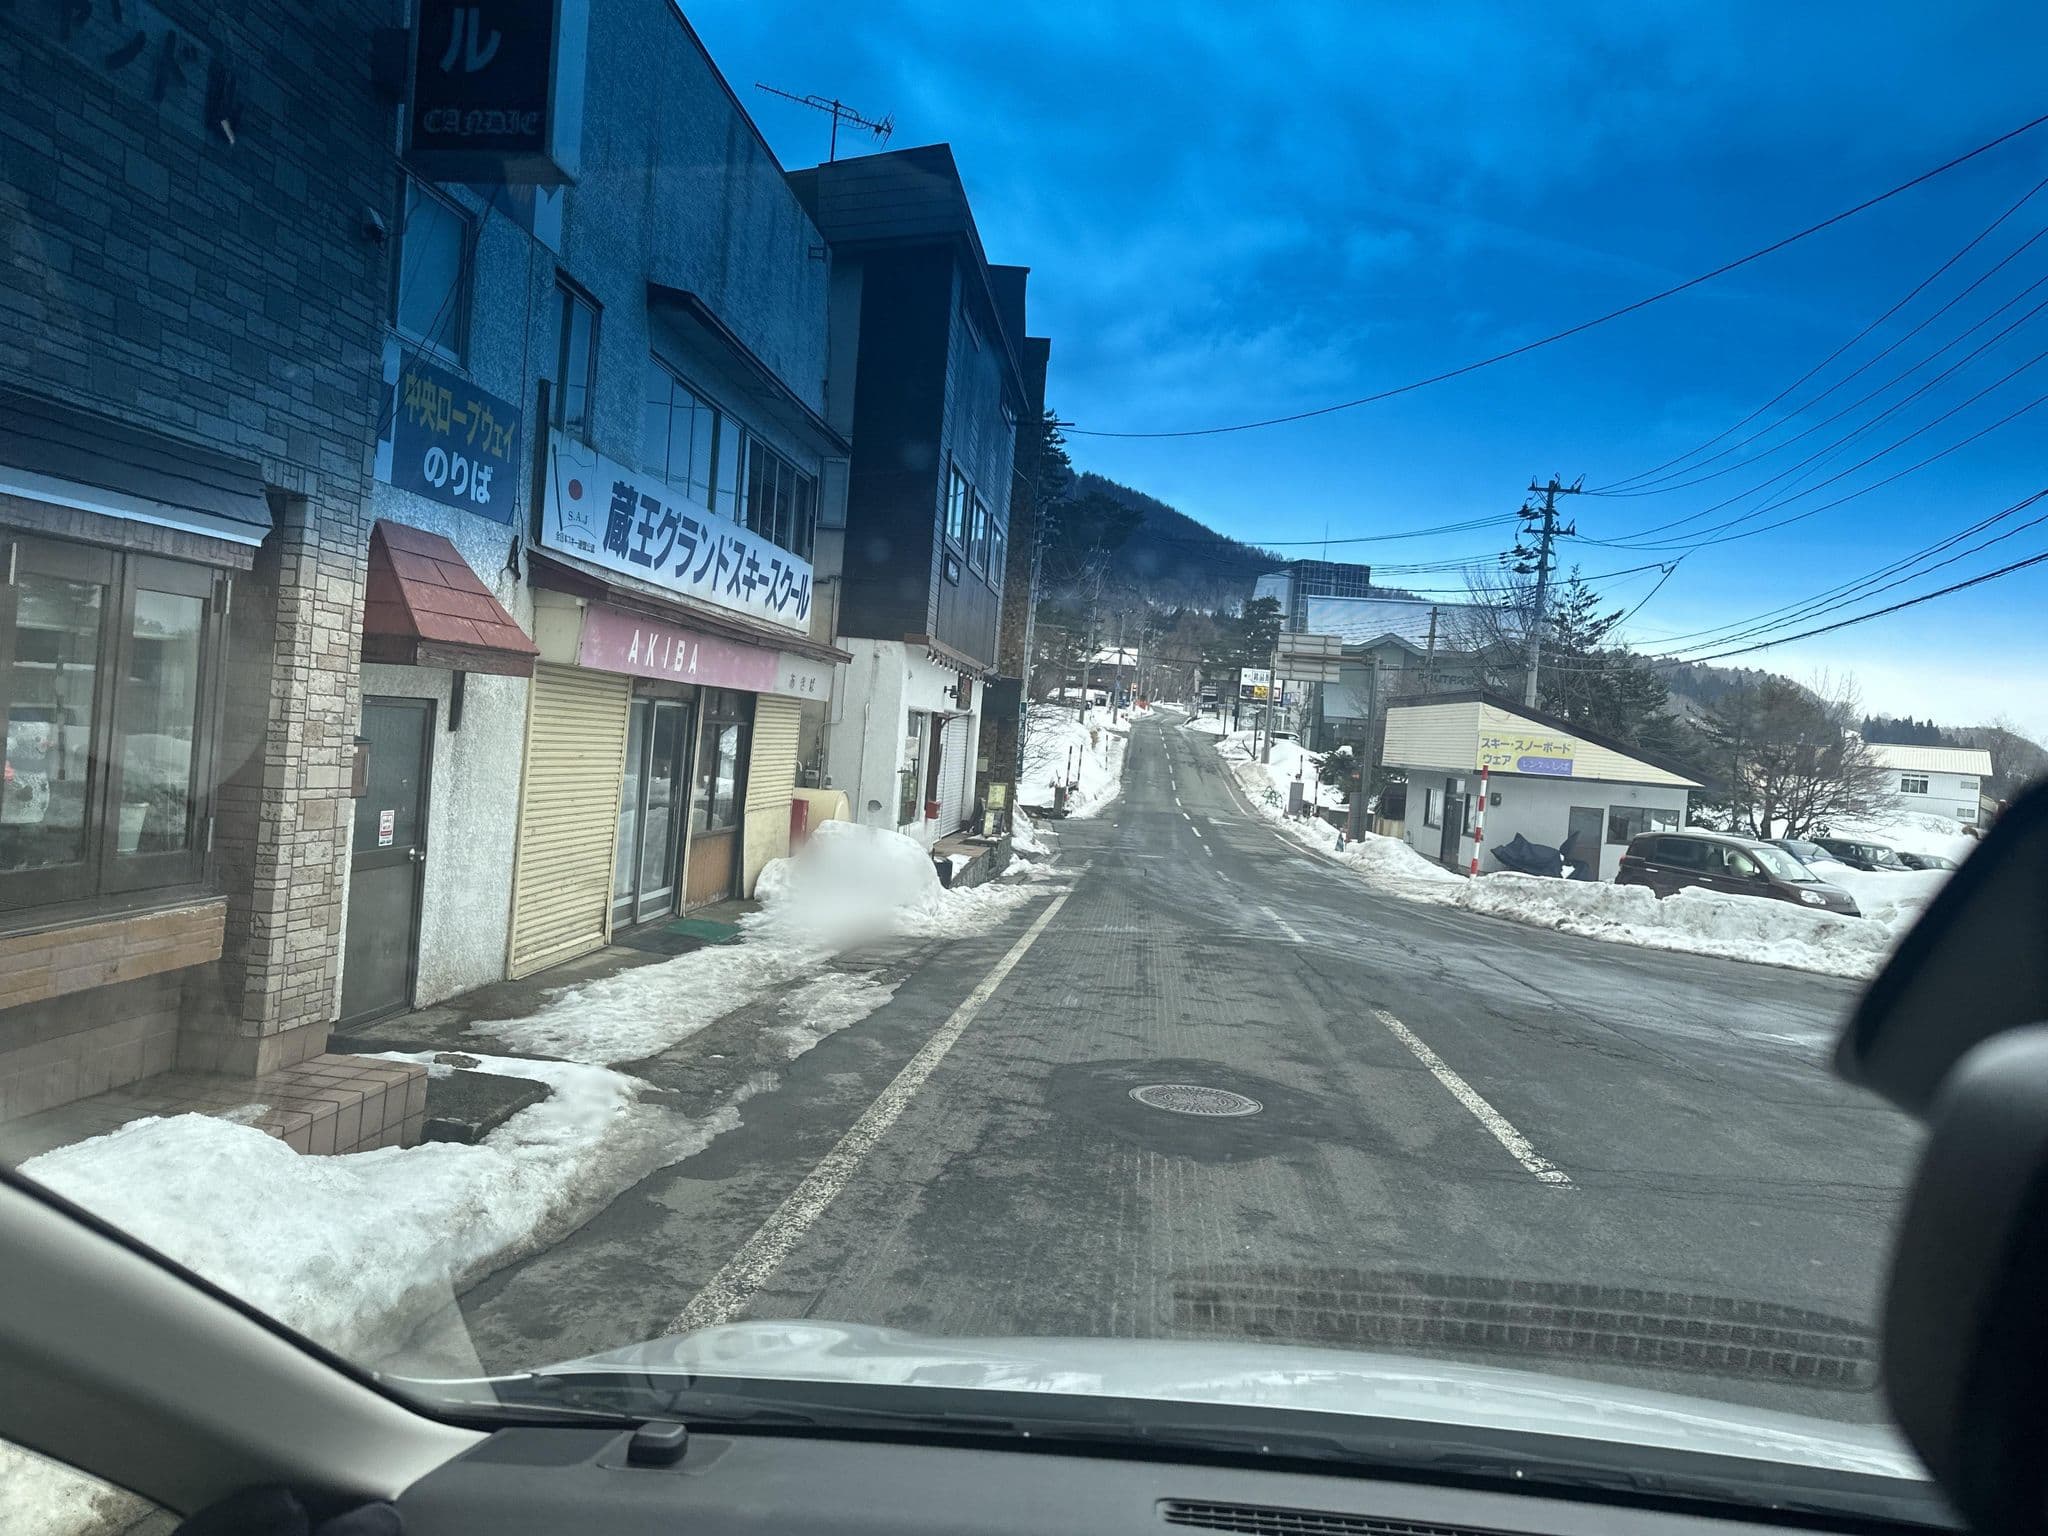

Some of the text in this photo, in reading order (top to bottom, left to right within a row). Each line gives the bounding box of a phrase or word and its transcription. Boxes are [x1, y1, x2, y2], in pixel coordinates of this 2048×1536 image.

[404, 368, 516, 463] 中央ロープウェイ
[423, 446, 494, 504] のりば
[602, 480, 810, 621] 蔵王グランドスキースクール
[628, 629, 698, 675] AKIBA
[1481, 737, 1571, 754] スキー・スノーボード
[1483, 754, 1512, 766] ウェア
